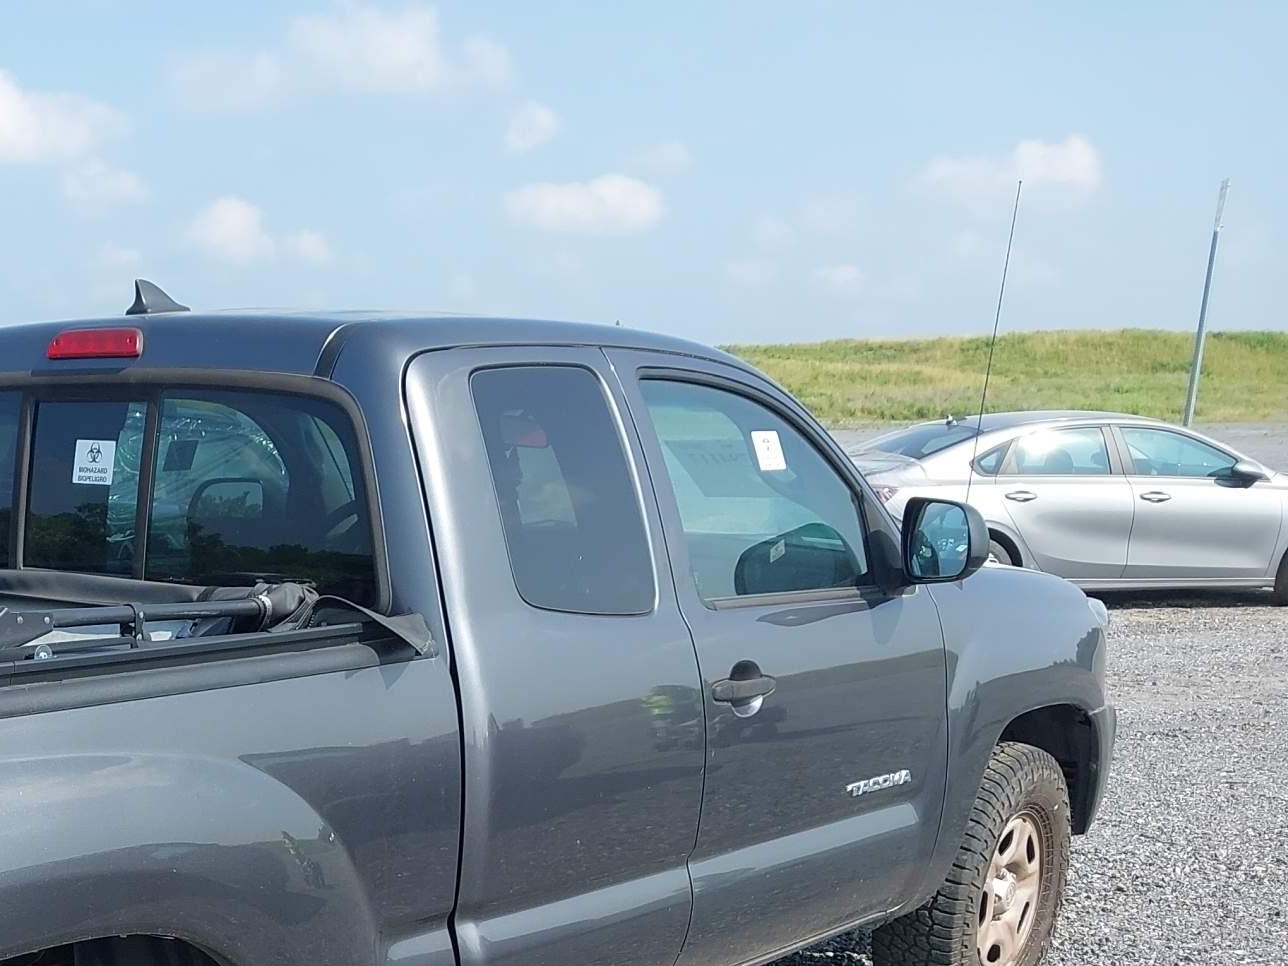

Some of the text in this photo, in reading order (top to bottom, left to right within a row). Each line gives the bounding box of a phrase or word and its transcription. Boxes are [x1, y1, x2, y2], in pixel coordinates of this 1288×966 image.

[78, 466, 108, 474] BIOHAZARD
[77, 475, 108, 483] BIOPELIGRO
[845, 769, 912, 797] TACOMA
